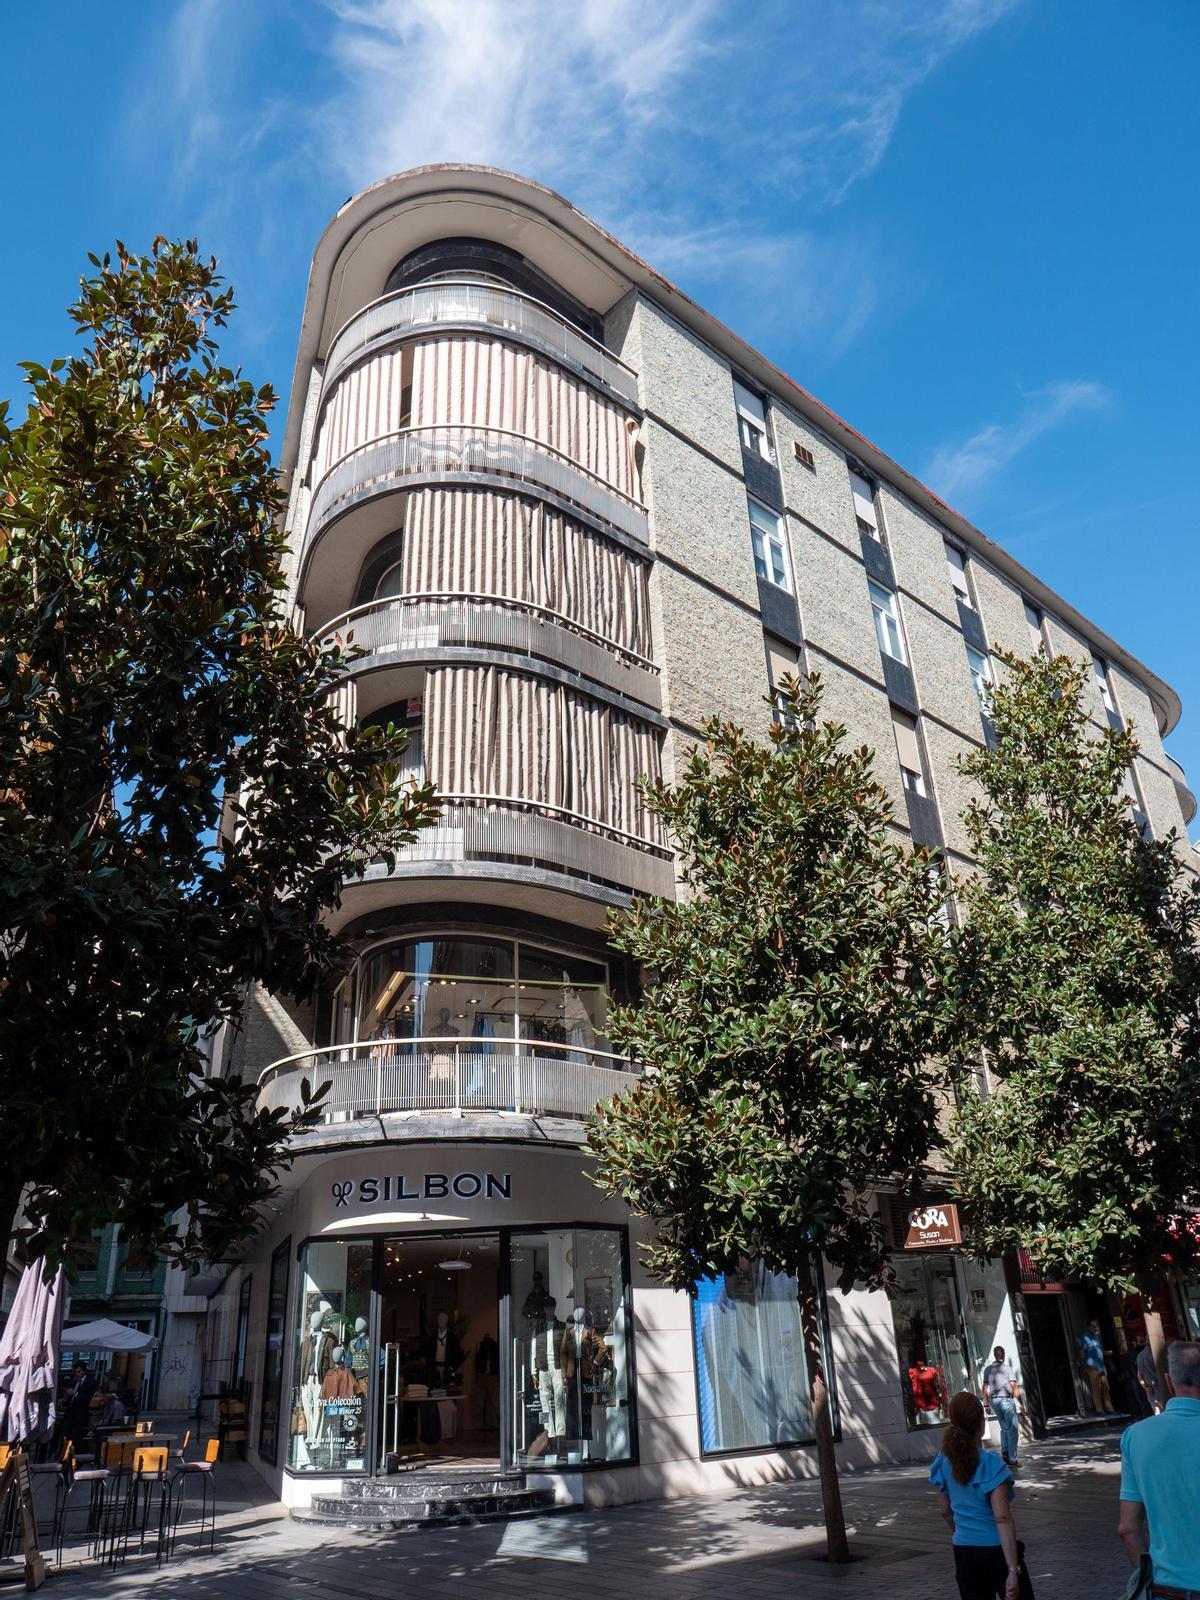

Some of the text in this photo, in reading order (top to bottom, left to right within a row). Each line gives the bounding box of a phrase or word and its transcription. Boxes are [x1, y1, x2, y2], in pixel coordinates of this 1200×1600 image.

[359, 1173, 511, 1203] SILBON
[907, 1208, 949, 1230] CORA
[328, 1395, 362, 1406] Colección
